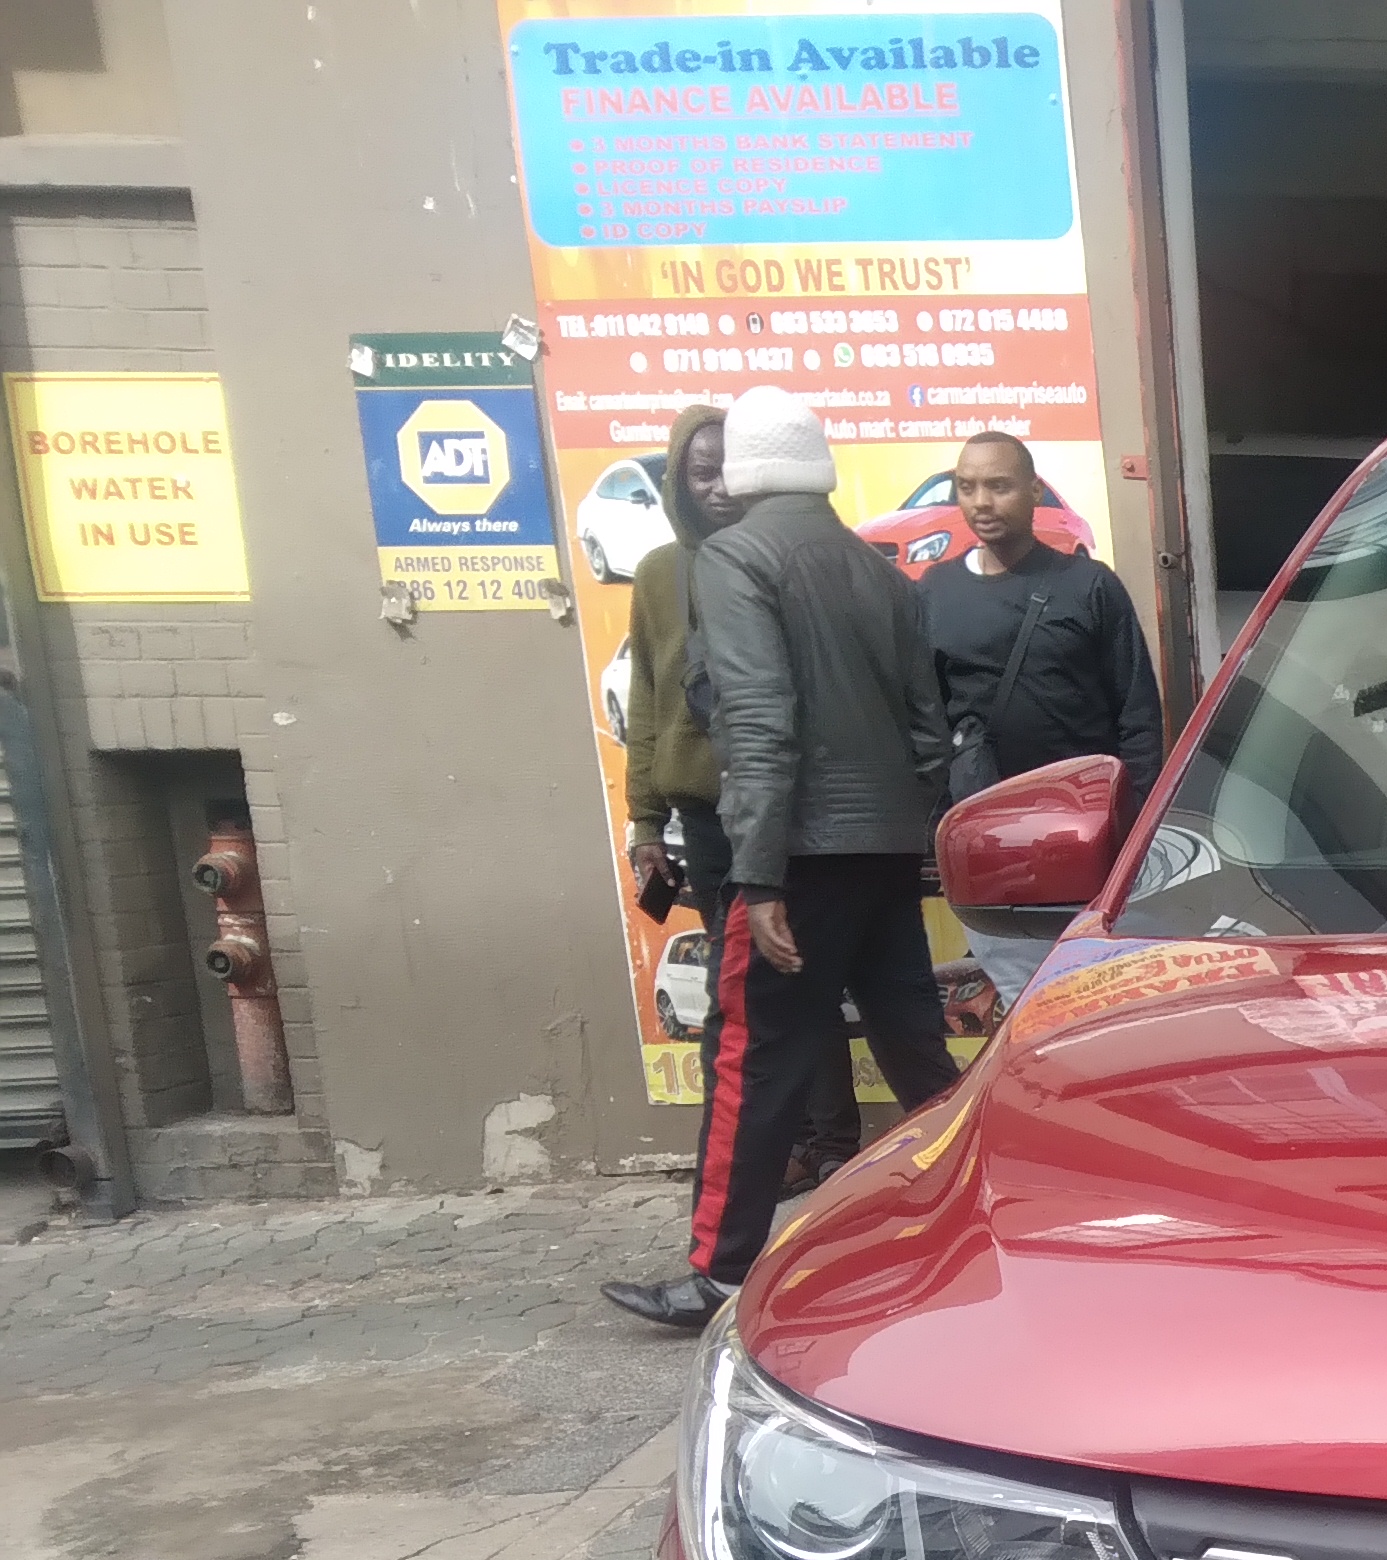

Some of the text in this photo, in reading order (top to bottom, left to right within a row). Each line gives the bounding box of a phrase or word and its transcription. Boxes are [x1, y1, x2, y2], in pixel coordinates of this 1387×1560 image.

[544, 36, 1041, 75] Trade-in Available
[562, 82, 960, 116] FINANCE AVAILABLE
[591, 131, 974, 152] 3 MONTHS BANK STATEMENT
[594, 156, 882, 176] PROOF OF RESIDENCE
[596, 178, 788, 196] LICENCE COPY
[600, 197, 848, 216] 3 MONTHS PAYSLIP
[602, 222, 706, 239] ID COPY
[716, 259, 784, 293] GOD
[796, 258, 846, 292] WE
[346, 351, 516, 368] IDELITY
[742, 346, 794, 372] 1437
[824, 418, 856, 439] Auto
[26, 431, 222, 455] BOREHOLE
[421, 438, 489, 477] ADT
[79, 522, 198, 546] IN USE
[409, 517, 519, 535] Always there
[393, 555, 546, 573] ARMED RESPONSE
[443, 579, 470, 601] 12
[477, 579, 503, 600] 12
